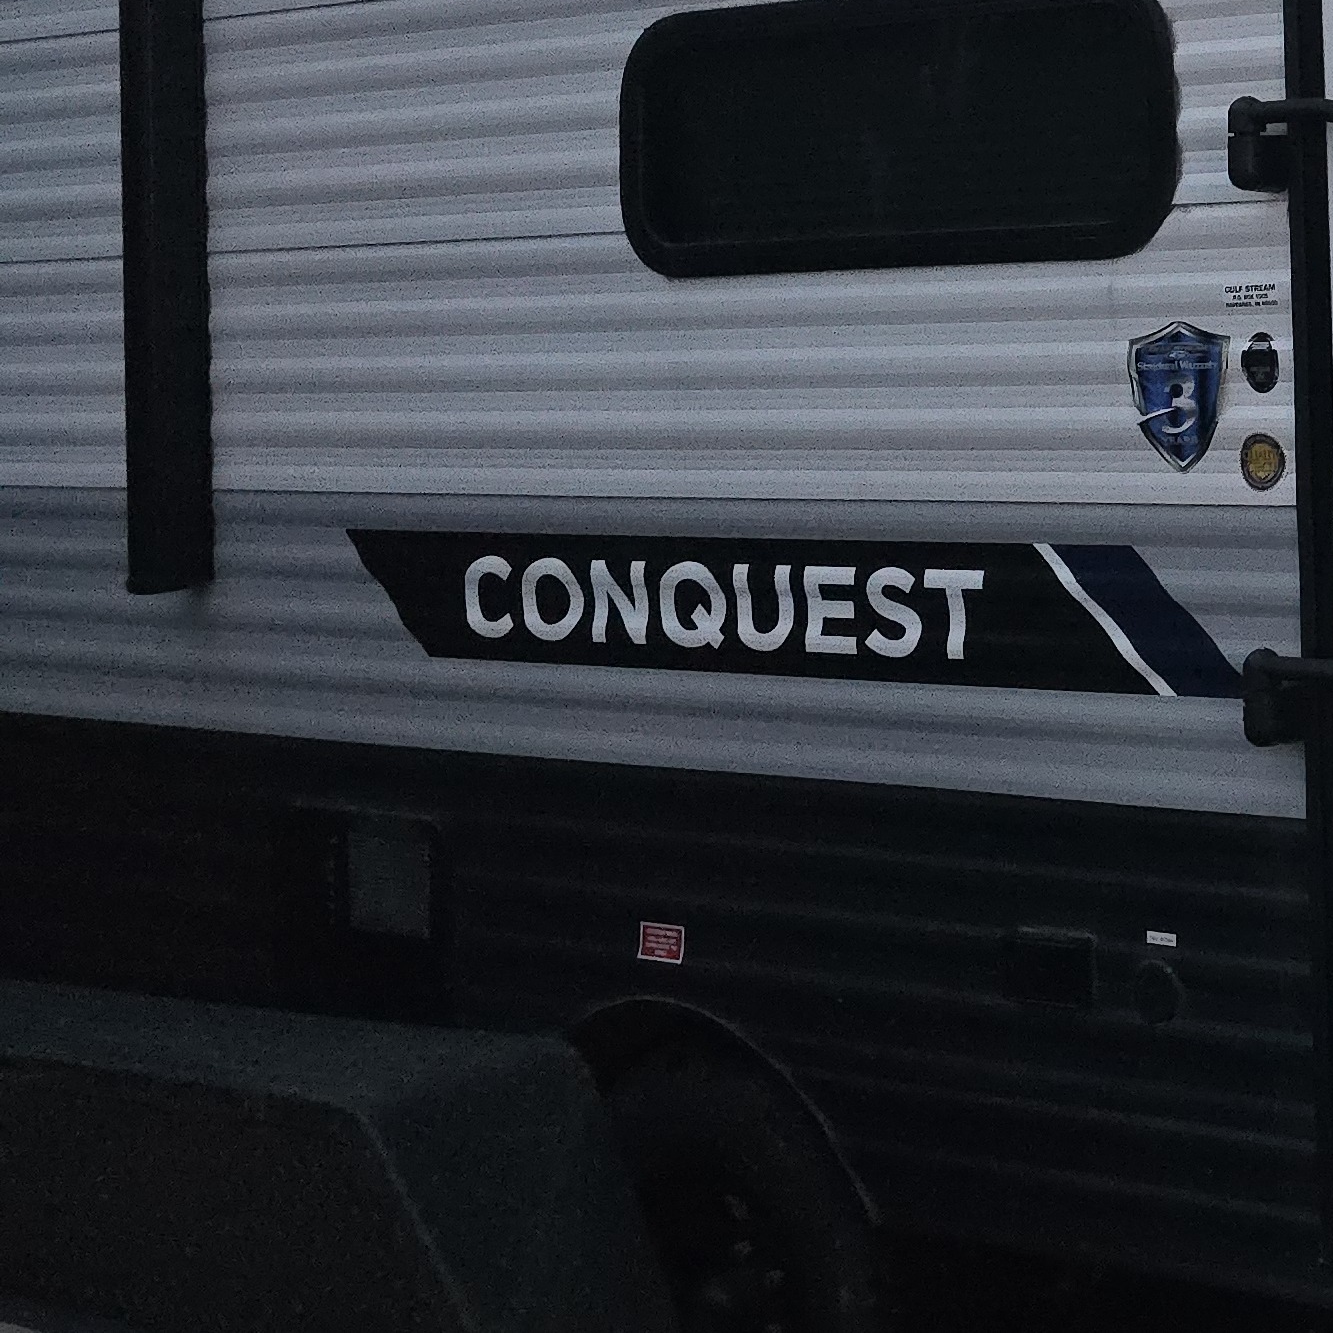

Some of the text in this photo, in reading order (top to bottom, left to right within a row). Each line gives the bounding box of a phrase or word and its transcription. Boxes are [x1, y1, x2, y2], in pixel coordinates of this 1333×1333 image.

[1224, 283, 1276, 294] GULF STREAM
[1161, 374, 1199, 434] 3
[464, 555, 985, 660] CONQUEST
